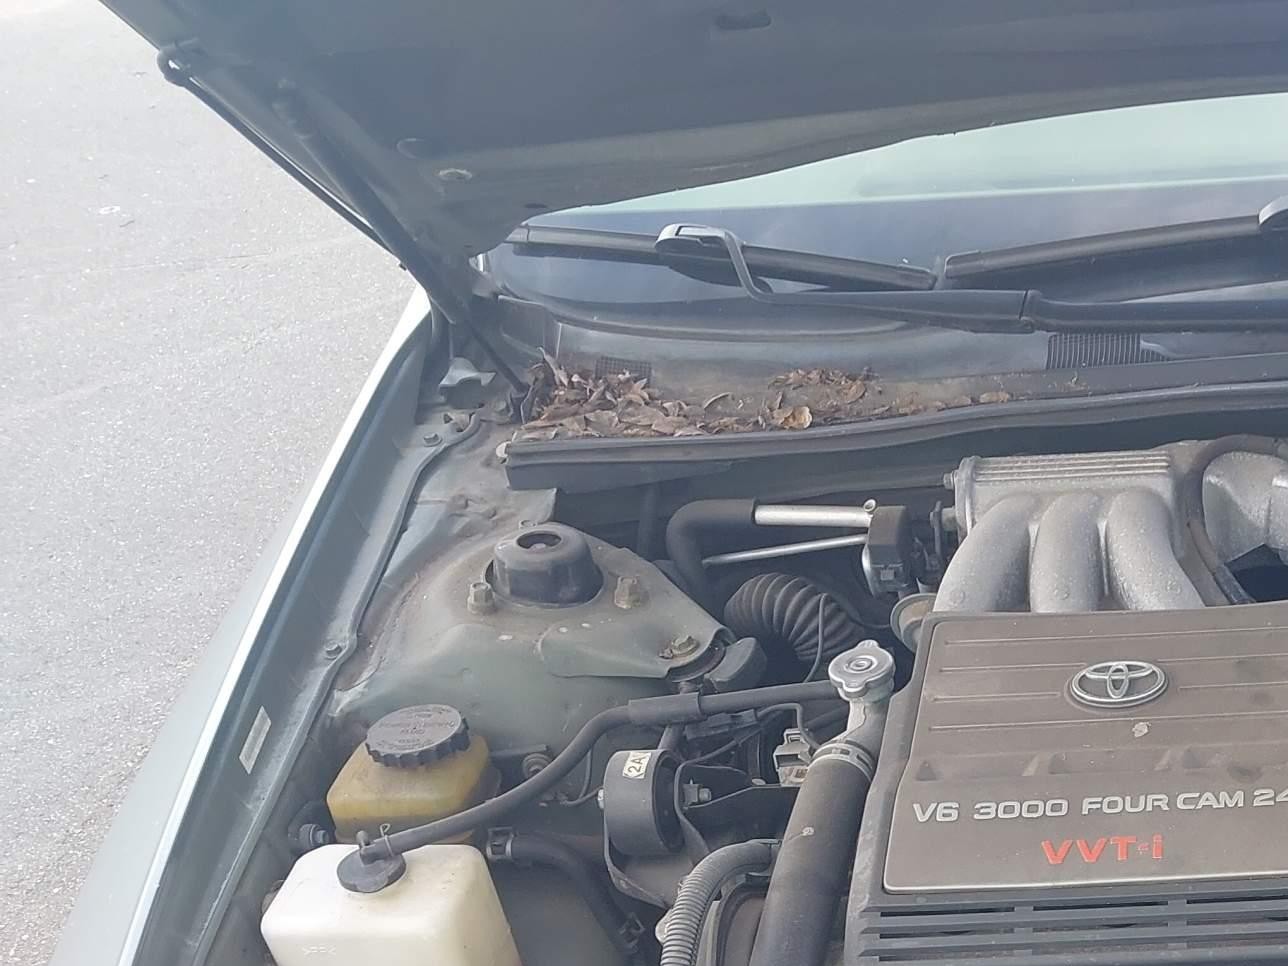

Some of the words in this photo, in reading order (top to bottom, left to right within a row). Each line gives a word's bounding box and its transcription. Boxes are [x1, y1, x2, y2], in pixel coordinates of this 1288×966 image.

[912, 801, 960, 823] V6
[973, 799, 1069, 820] 3000
[1081, 794, 1170, 816] FOUR
[1176, 790, 1245, 810] CAM
[1041, 834, 1165, 864] VVT-i
